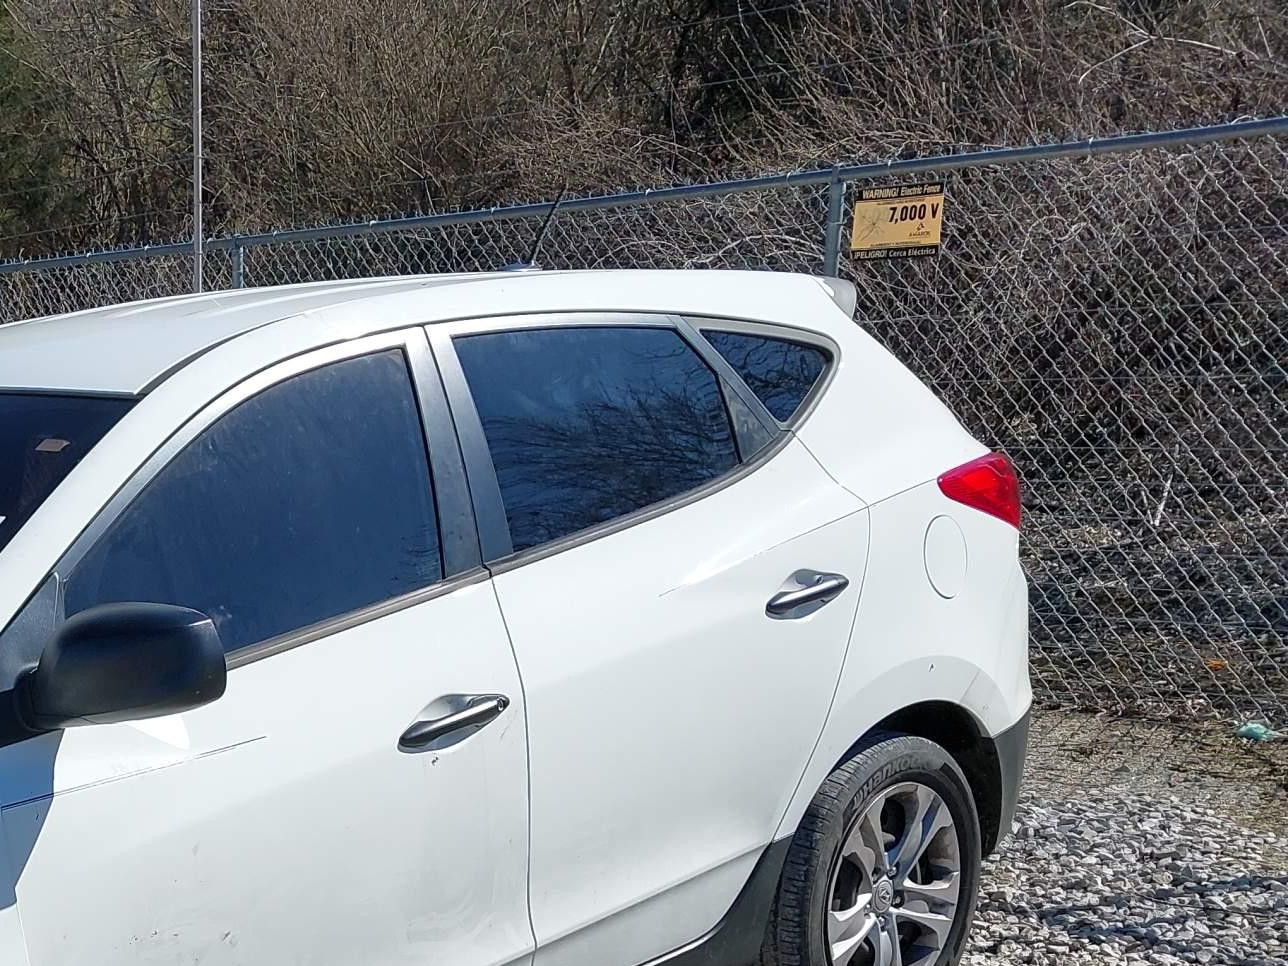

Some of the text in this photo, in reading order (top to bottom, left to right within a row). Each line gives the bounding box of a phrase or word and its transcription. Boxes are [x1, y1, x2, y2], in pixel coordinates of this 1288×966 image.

[862, 184, 941, 200] WARNING! Electric Fence
[888, 202, 939, 225] 7,000 V
[888, 249, 907, 258] Cerca
